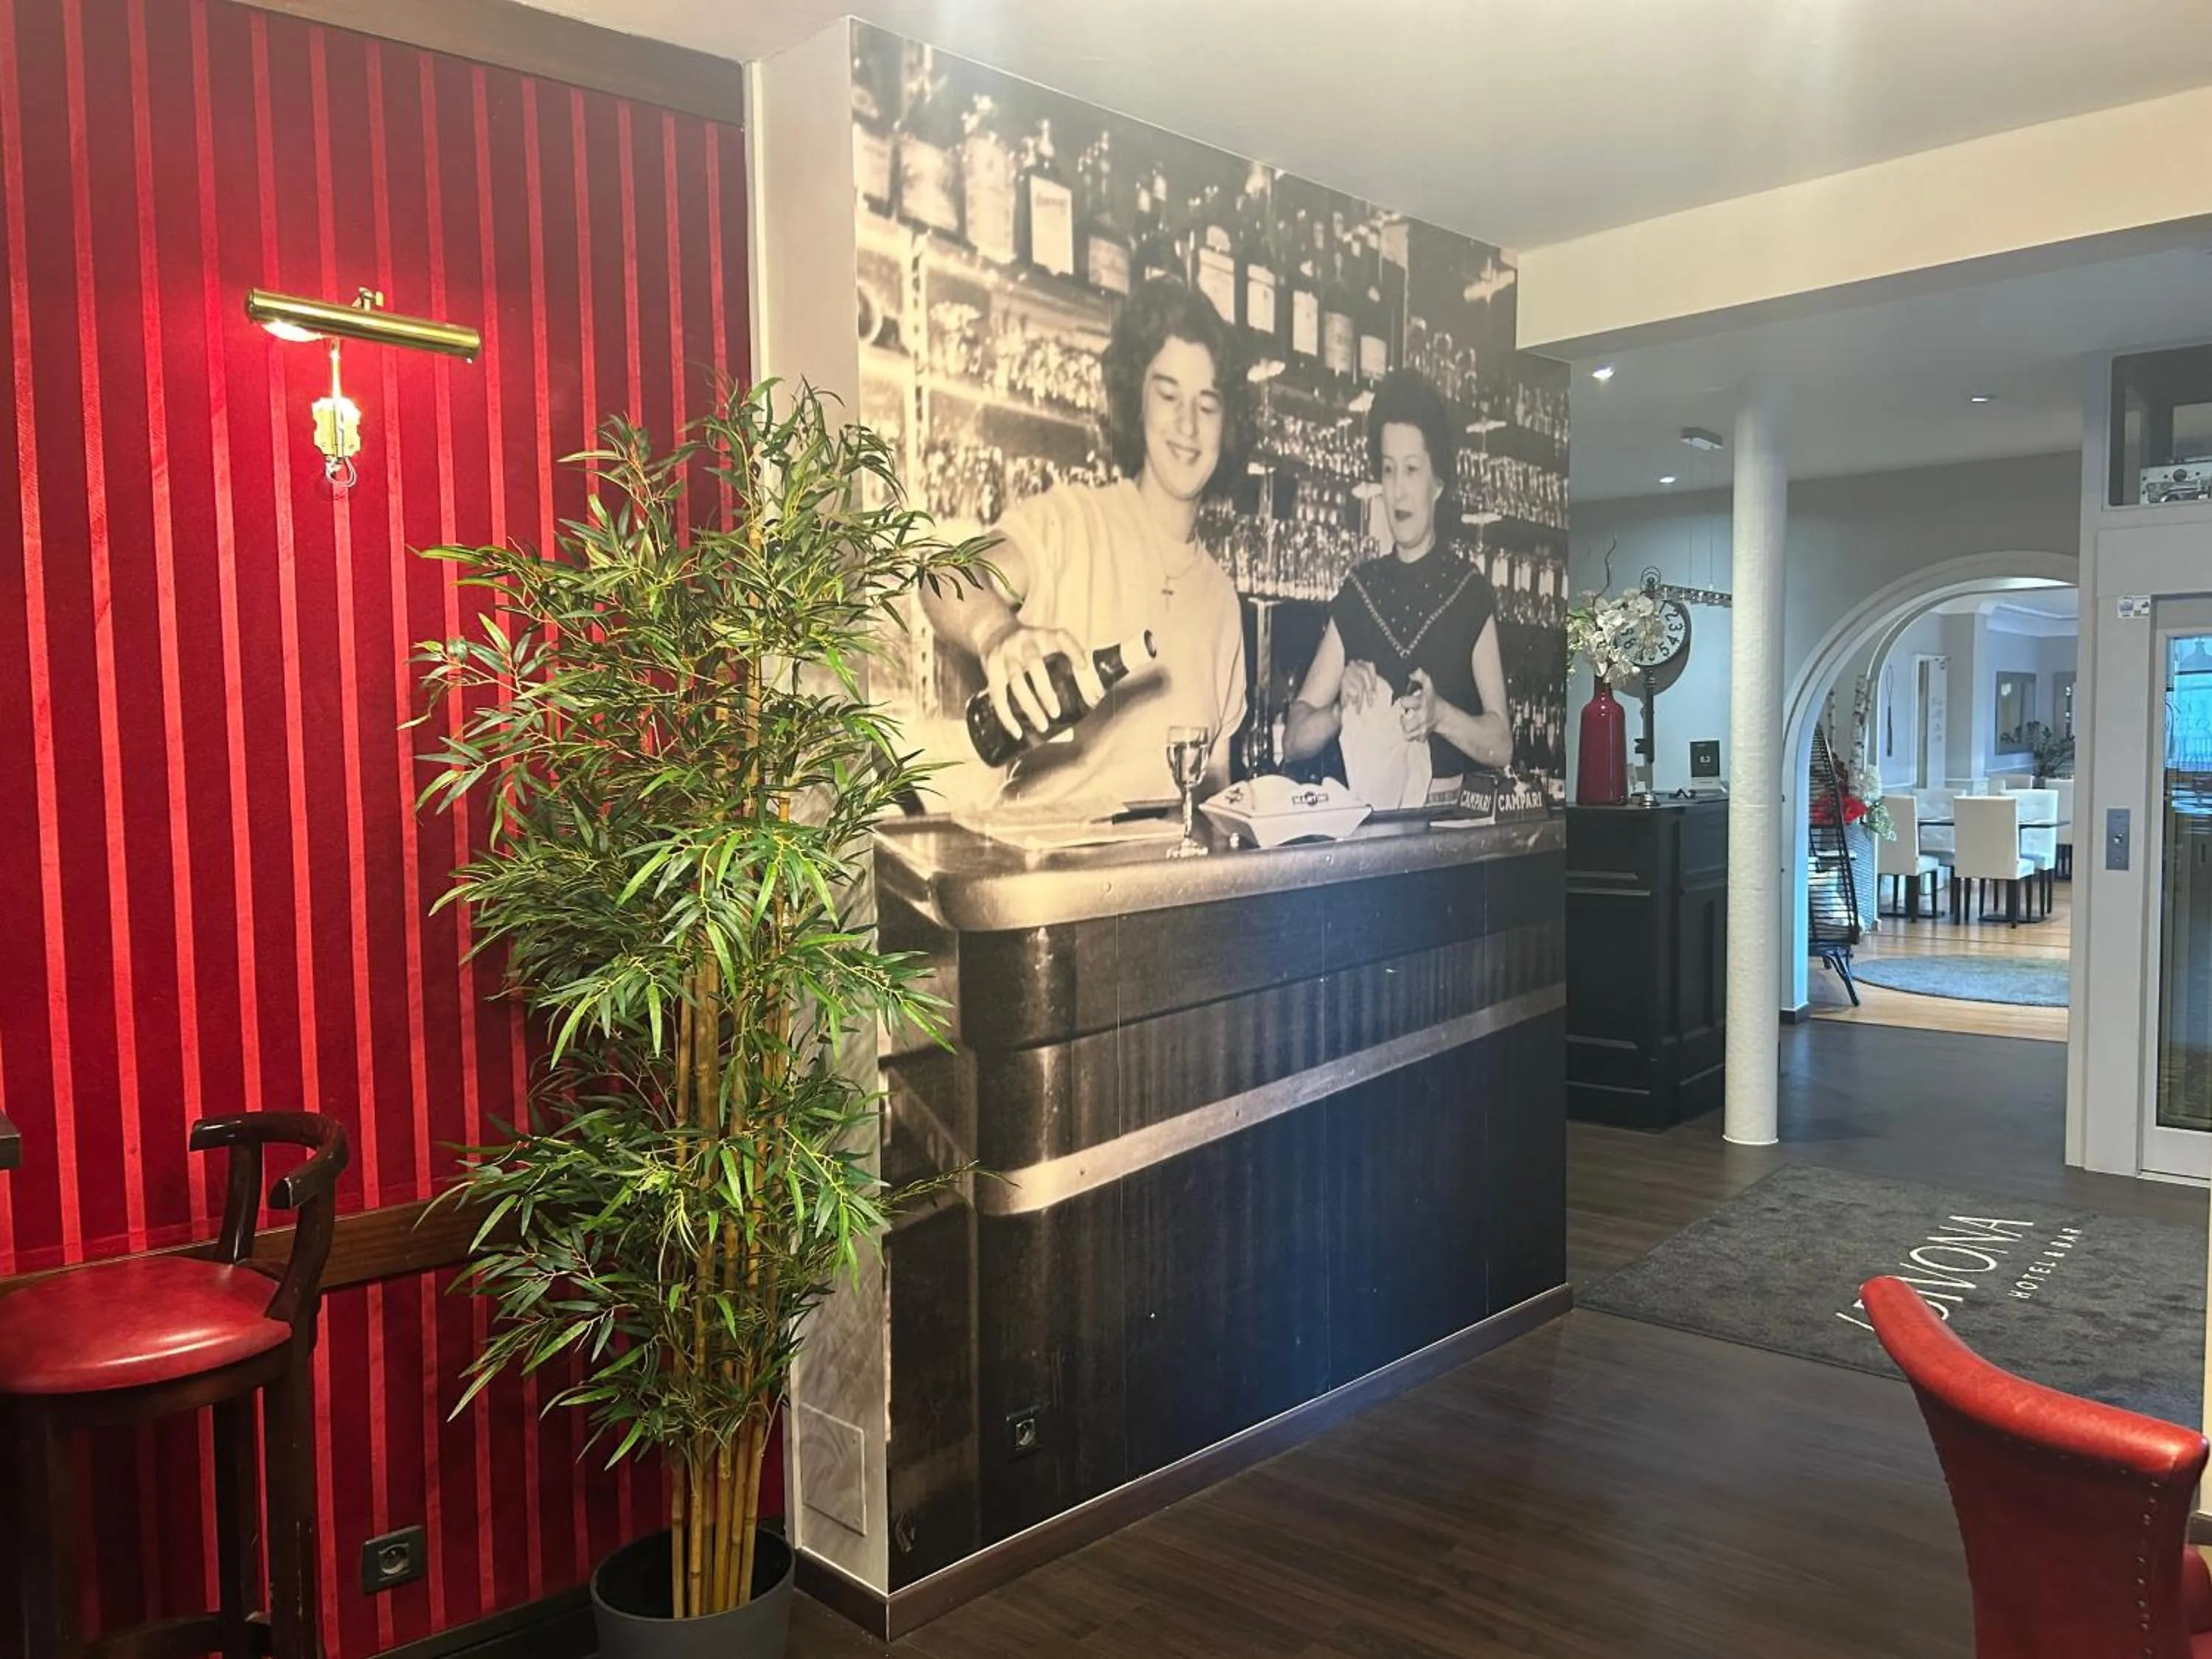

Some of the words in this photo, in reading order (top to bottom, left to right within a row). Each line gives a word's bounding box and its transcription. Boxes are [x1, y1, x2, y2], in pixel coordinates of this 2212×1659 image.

[1665, 608, 1680, 622] 2
[1669, 623, 1683, 631] 3
[1667, 636, 1680, 645] 4
[1658, 641, 1670, 656] 5
[1498, 791, 1543, 812] CAMPARI
[2007, 1262, 2056, 1298] HOTEL
[2051, 1228, 2083, 1248] BAR
